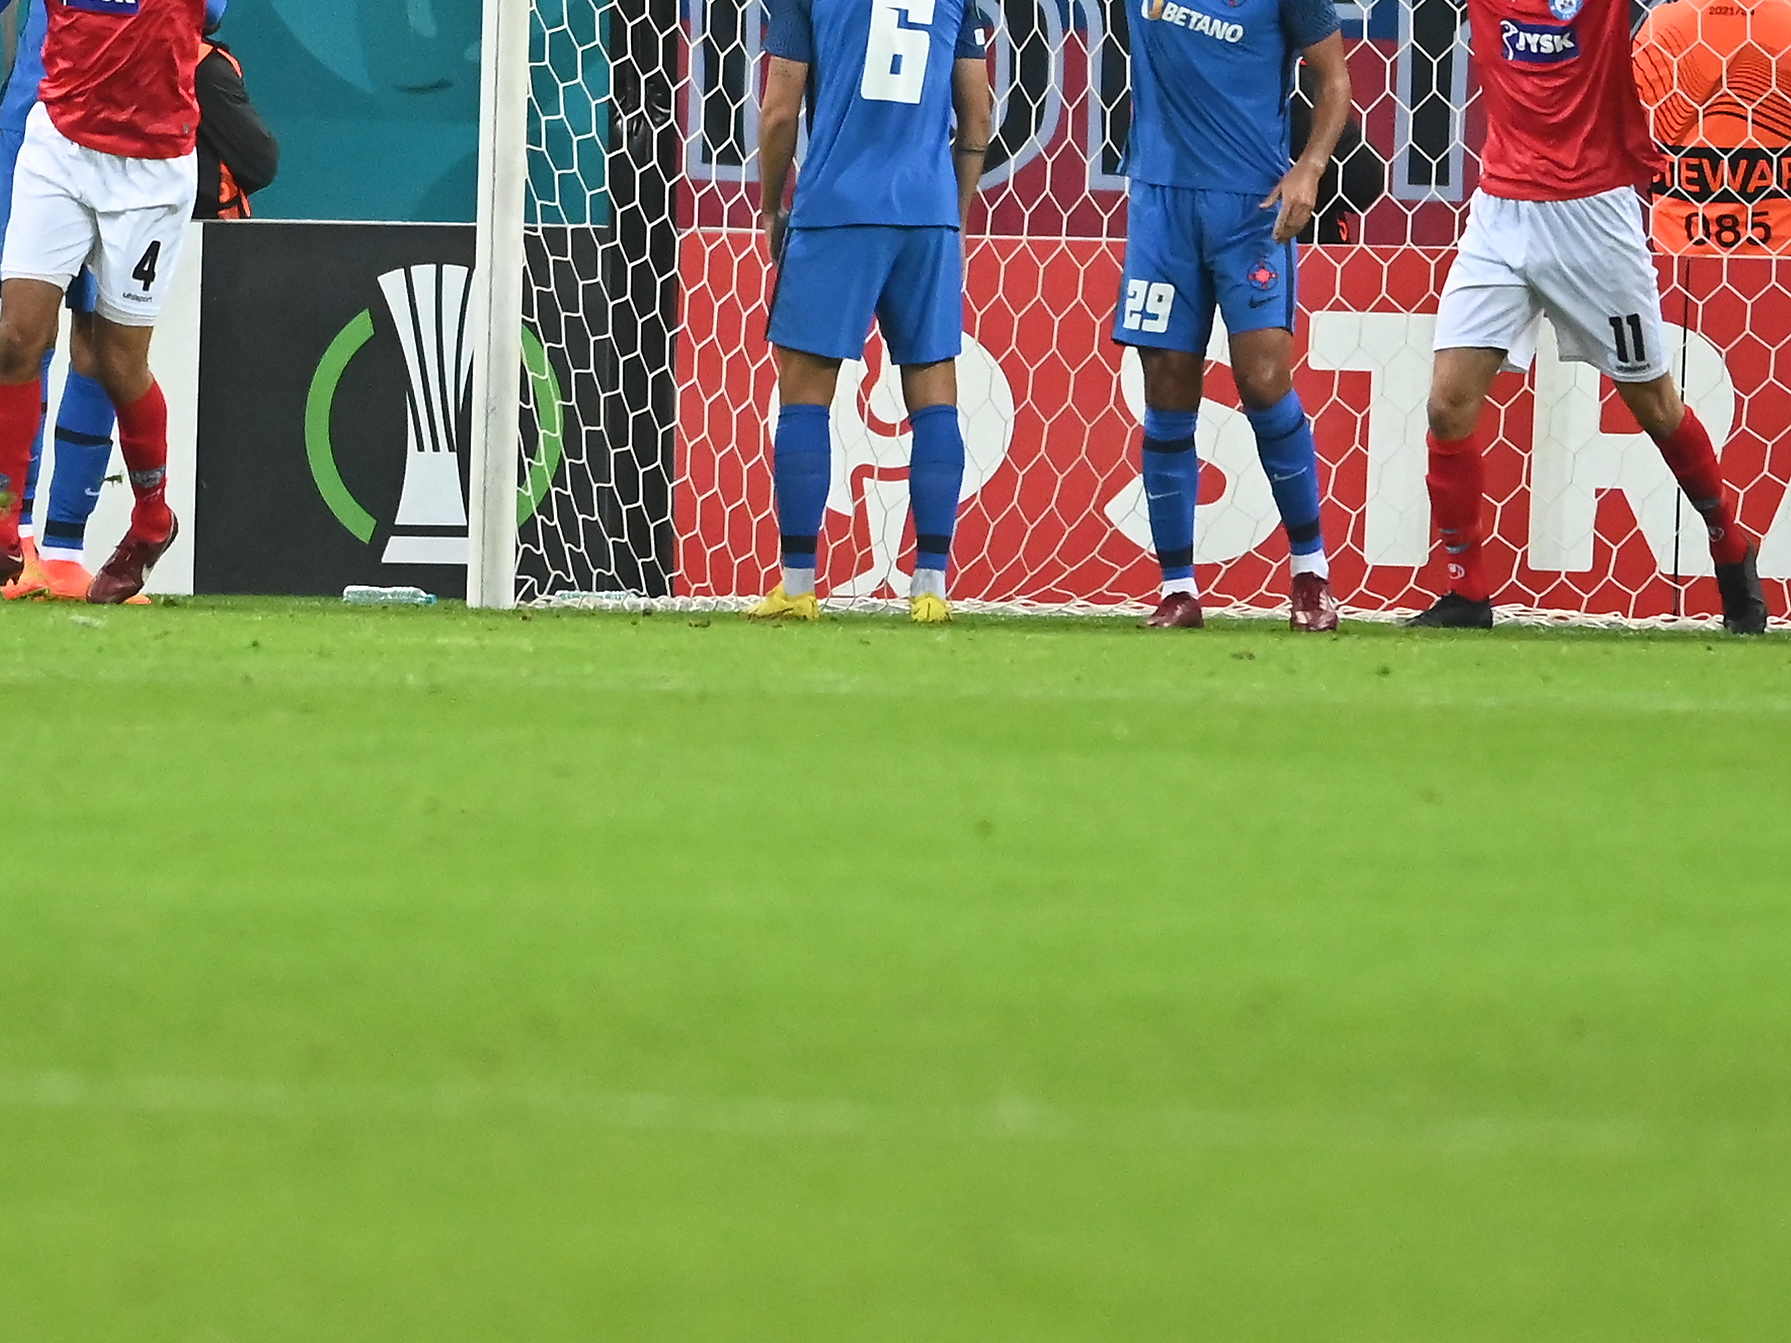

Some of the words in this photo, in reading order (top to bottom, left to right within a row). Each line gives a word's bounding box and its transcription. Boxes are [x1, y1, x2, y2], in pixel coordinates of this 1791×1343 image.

[1161, 1, 1244, 43] BETANO
[1516, 31, 1575, 54] JYSK
[1684, 210, 1772, 248] 085
[132, 240, 161, 291] 4
[1123, 279, 1175, 333] 29
[1609, 313, 1645, 363] 11
